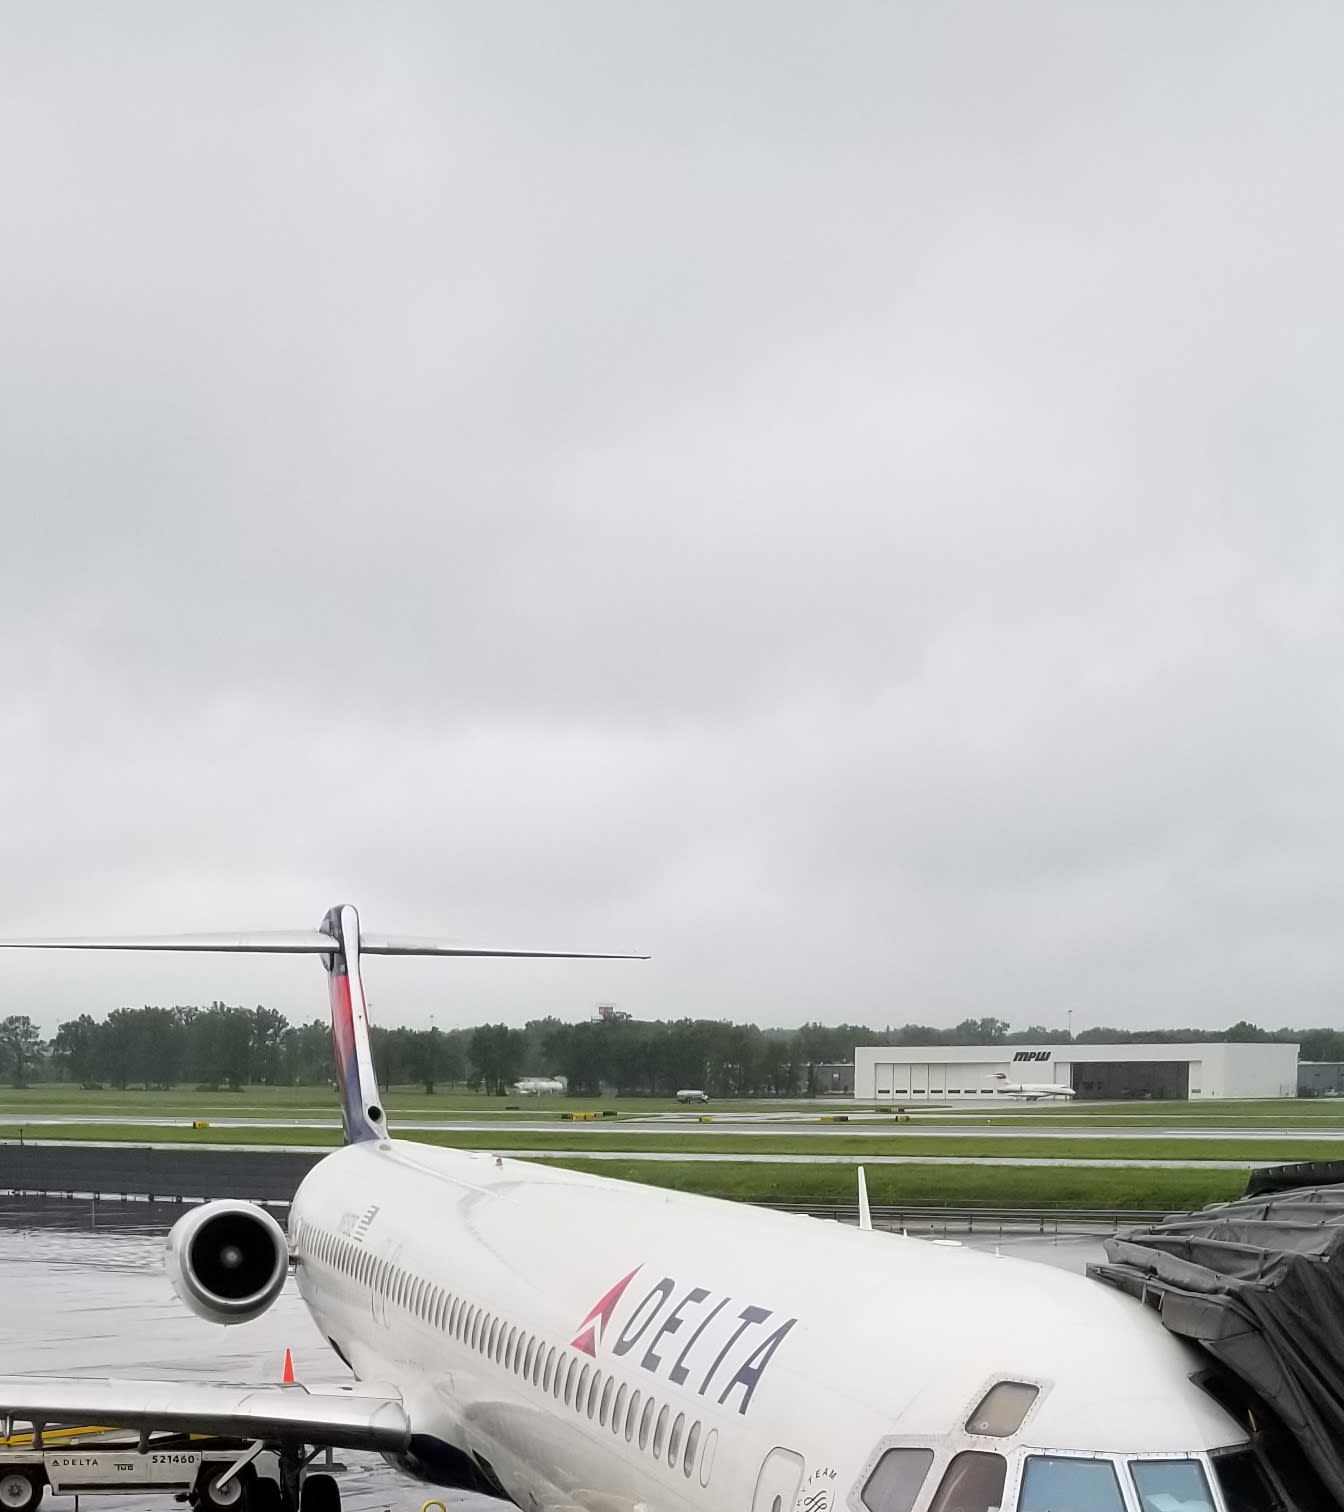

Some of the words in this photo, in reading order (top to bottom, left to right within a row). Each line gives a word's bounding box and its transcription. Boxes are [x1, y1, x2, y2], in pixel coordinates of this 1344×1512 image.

[1012, 1051, 1052, 1062] MPW
[611, 1276, 799, 1416] DELTA
[63, 1458, 99, 1466] DELTA
[151, 1455, 195, 1464] 521460
